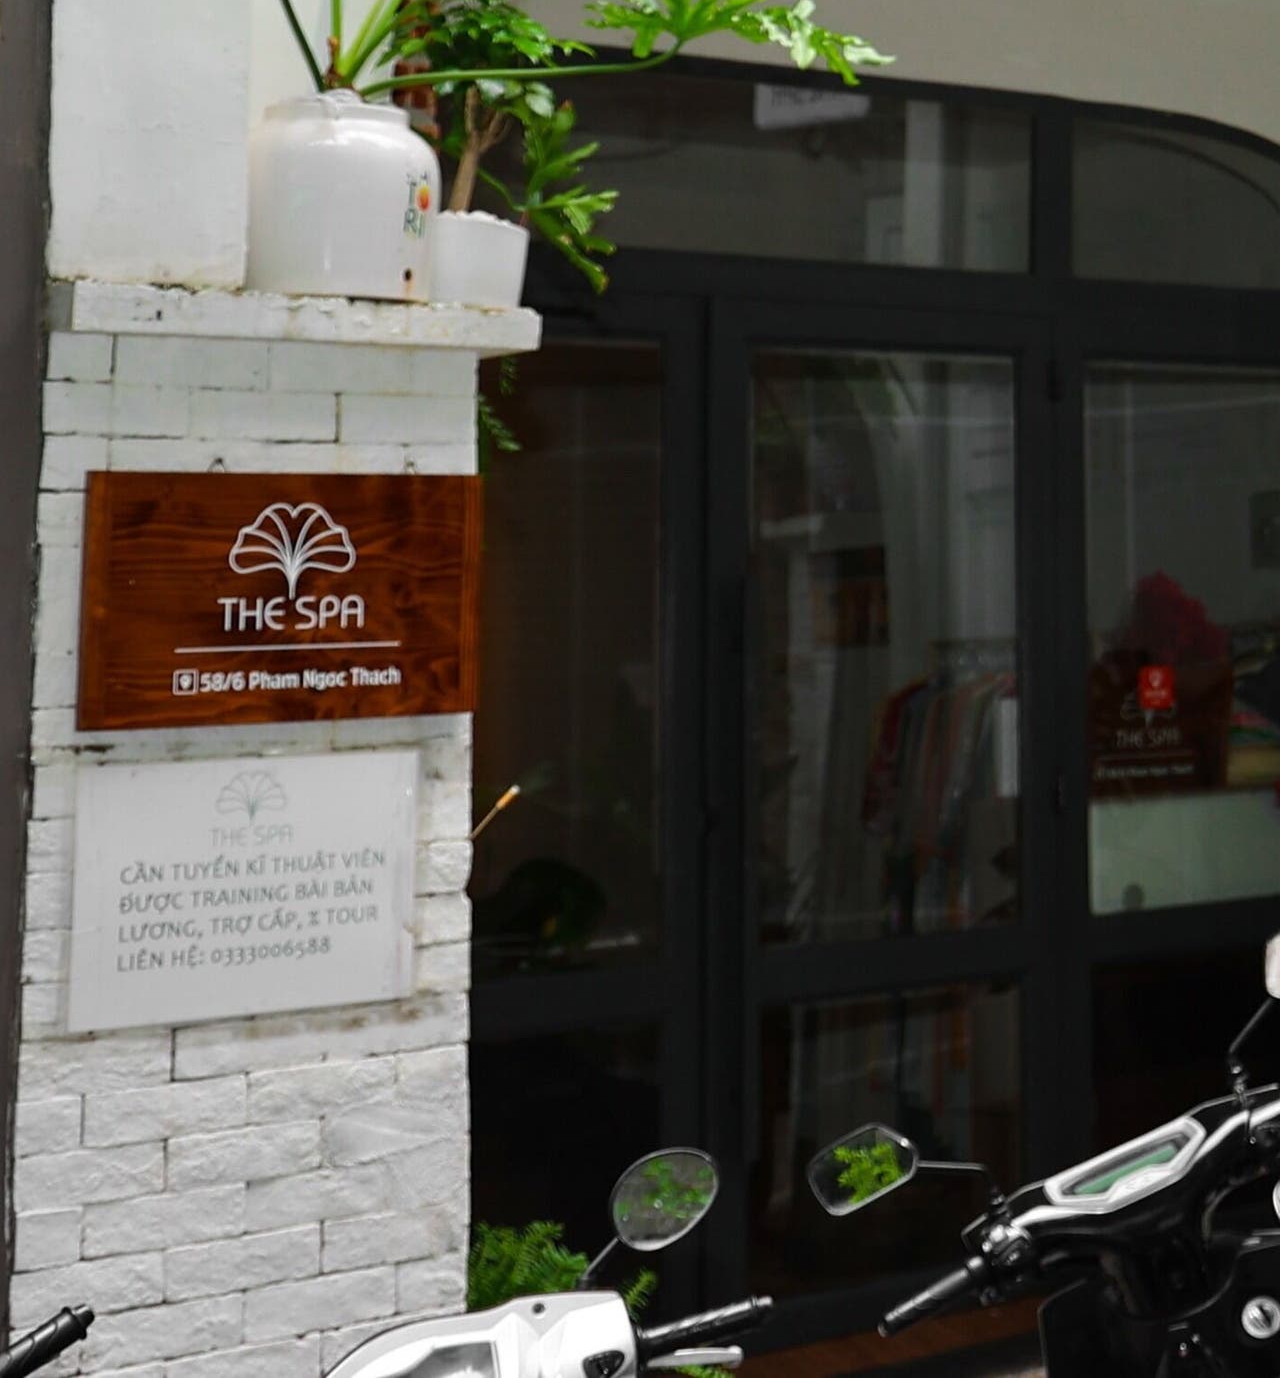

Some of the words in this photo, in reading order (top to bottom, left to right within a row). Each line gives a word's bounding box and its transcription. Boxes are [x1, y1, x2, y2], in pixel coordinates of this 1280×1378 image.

[217, 596, 286, 632] THE
[293, 593, 366, 630] SPA
[199, 670, 246, 693] 58/6
[248, 670, 301, 691] Pham
[302, 668, 347, 691] Ngoc
[349, 665, 402, 686] Thach
[209, 827, 249, 848] THE
[253, 823, 295, 847] SPA
[190, 882, 290, 911] TRAINING
[327, 904, 379, 926] TOUR
[116, 948, 164, 972] LIÊN
